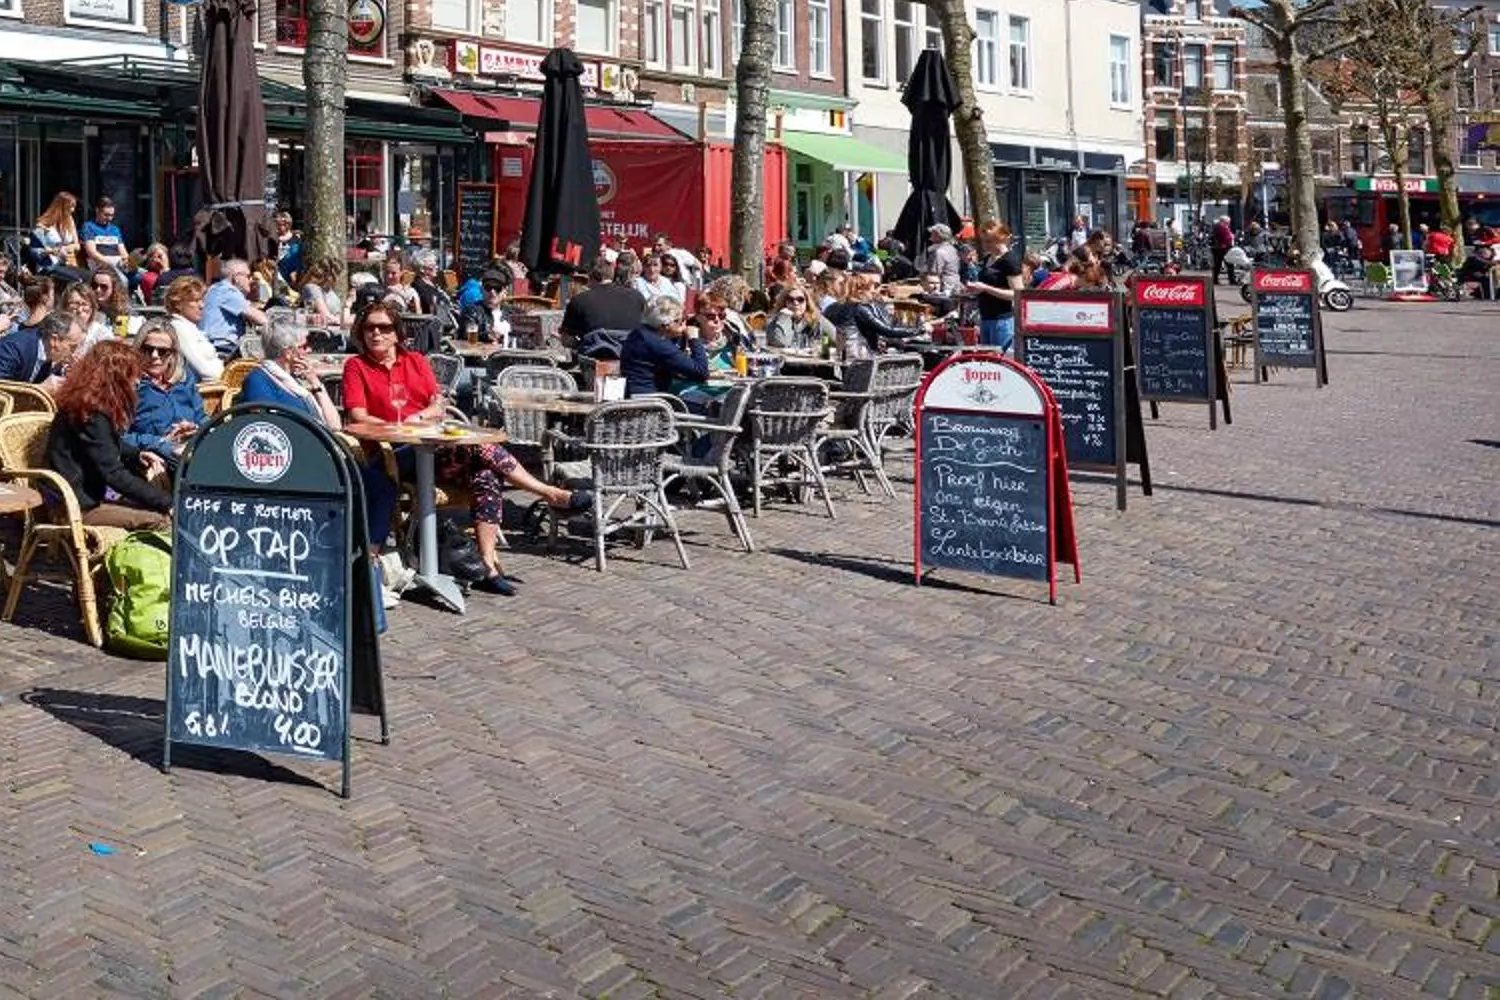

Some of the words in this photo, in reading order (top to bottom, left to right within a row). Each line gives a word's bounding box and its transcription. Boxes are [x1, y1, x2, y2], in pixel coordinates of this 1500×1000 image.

[1376, 179, 1421, 192] VENZIA
[1143, 283, 1199, 301] Coca-Cola
[962, 367, 1002, 384] Jopen
[240, 449, 285, 472] Jopen
[231, 502, 248, 516] DE
[247, 525, 311, 574] TAP
